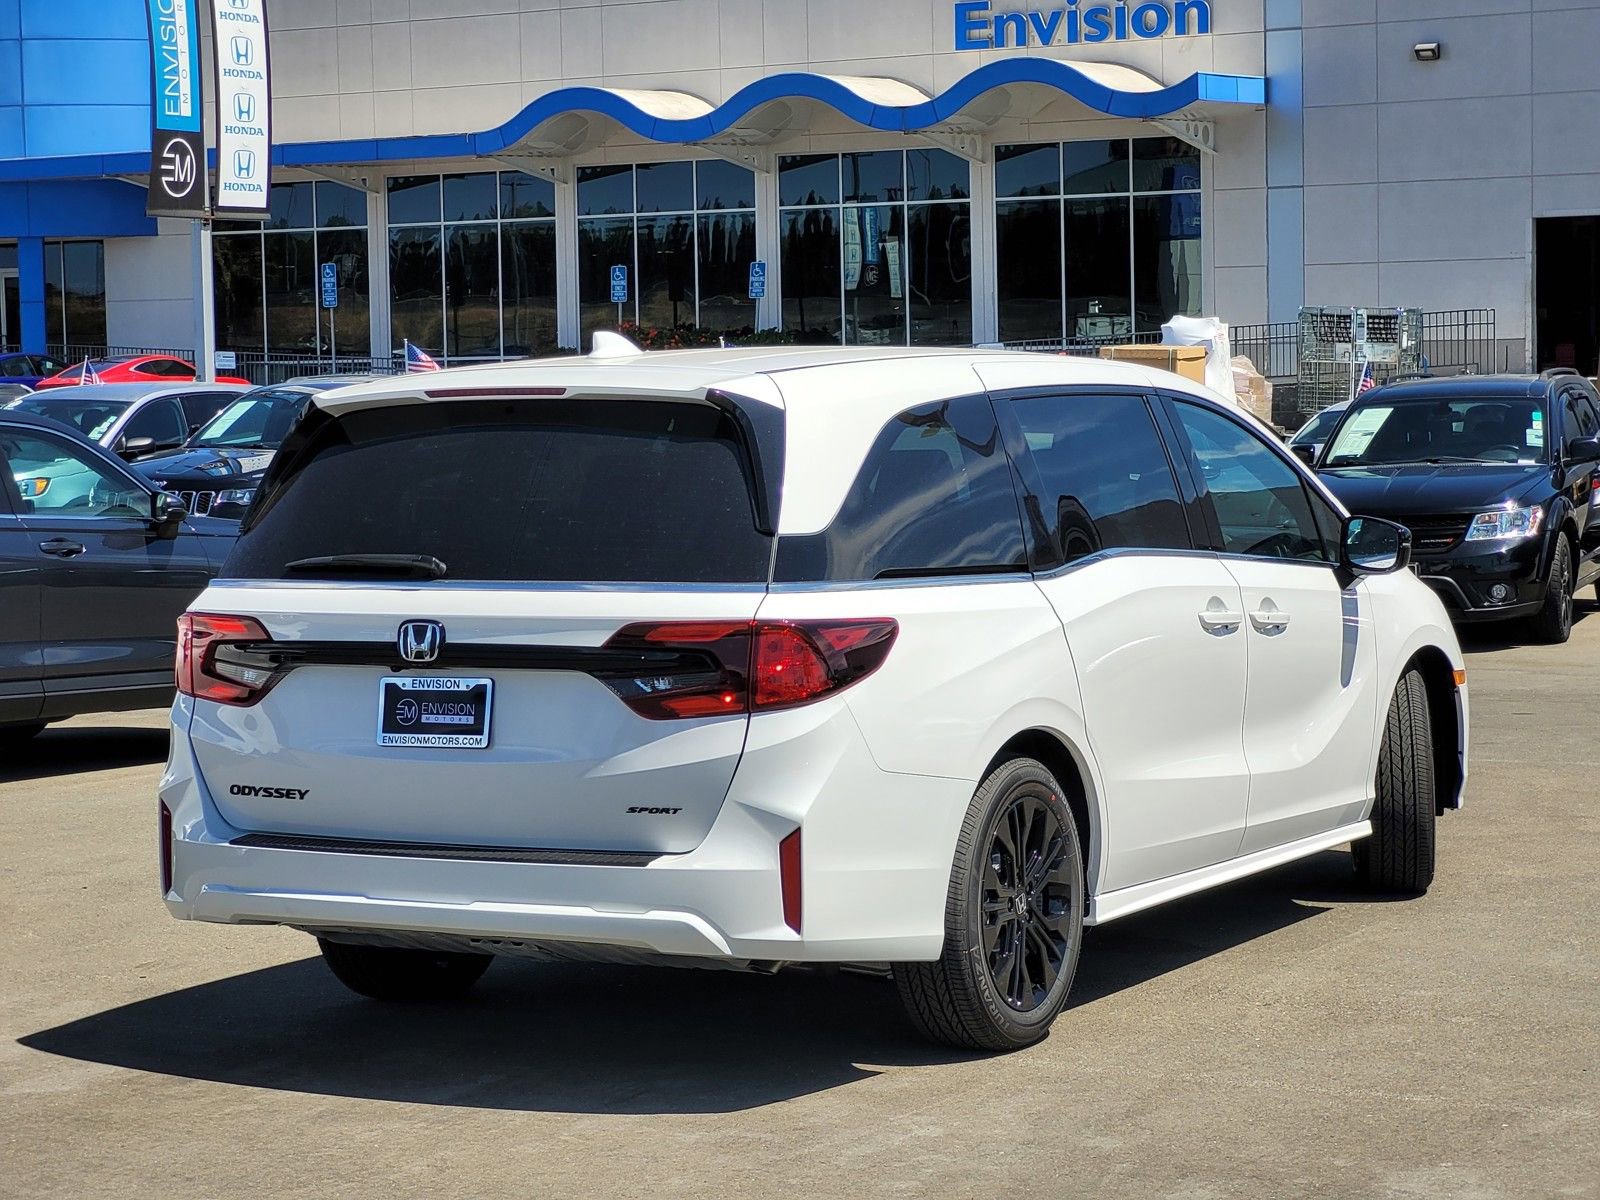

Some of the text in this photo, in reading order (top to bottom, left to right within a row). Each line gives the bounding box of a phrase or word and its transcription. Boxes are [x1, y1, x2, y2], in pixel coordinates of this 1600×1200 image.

[219, 11, 260, 23] HONDA
[955, 0, 1211, 51] Envision
[158, 0, 180, 116] ENVISIO
[176, 4, 189, 104] MOTOR
[223, 68, 263, 80] HONDA
[224, 125, 265, 137] HONDA
[223, 182, 263, 192] HONDA
[411, 679, 461, 690] ENVISION
[421, 702, 475, 715] ENVISION
[382, 736, 483, 746] ENVISIONMOTORS.COM
[229, 784, 310, 800] ODYSSEY
[625, 806, 683, 815] SPORT
